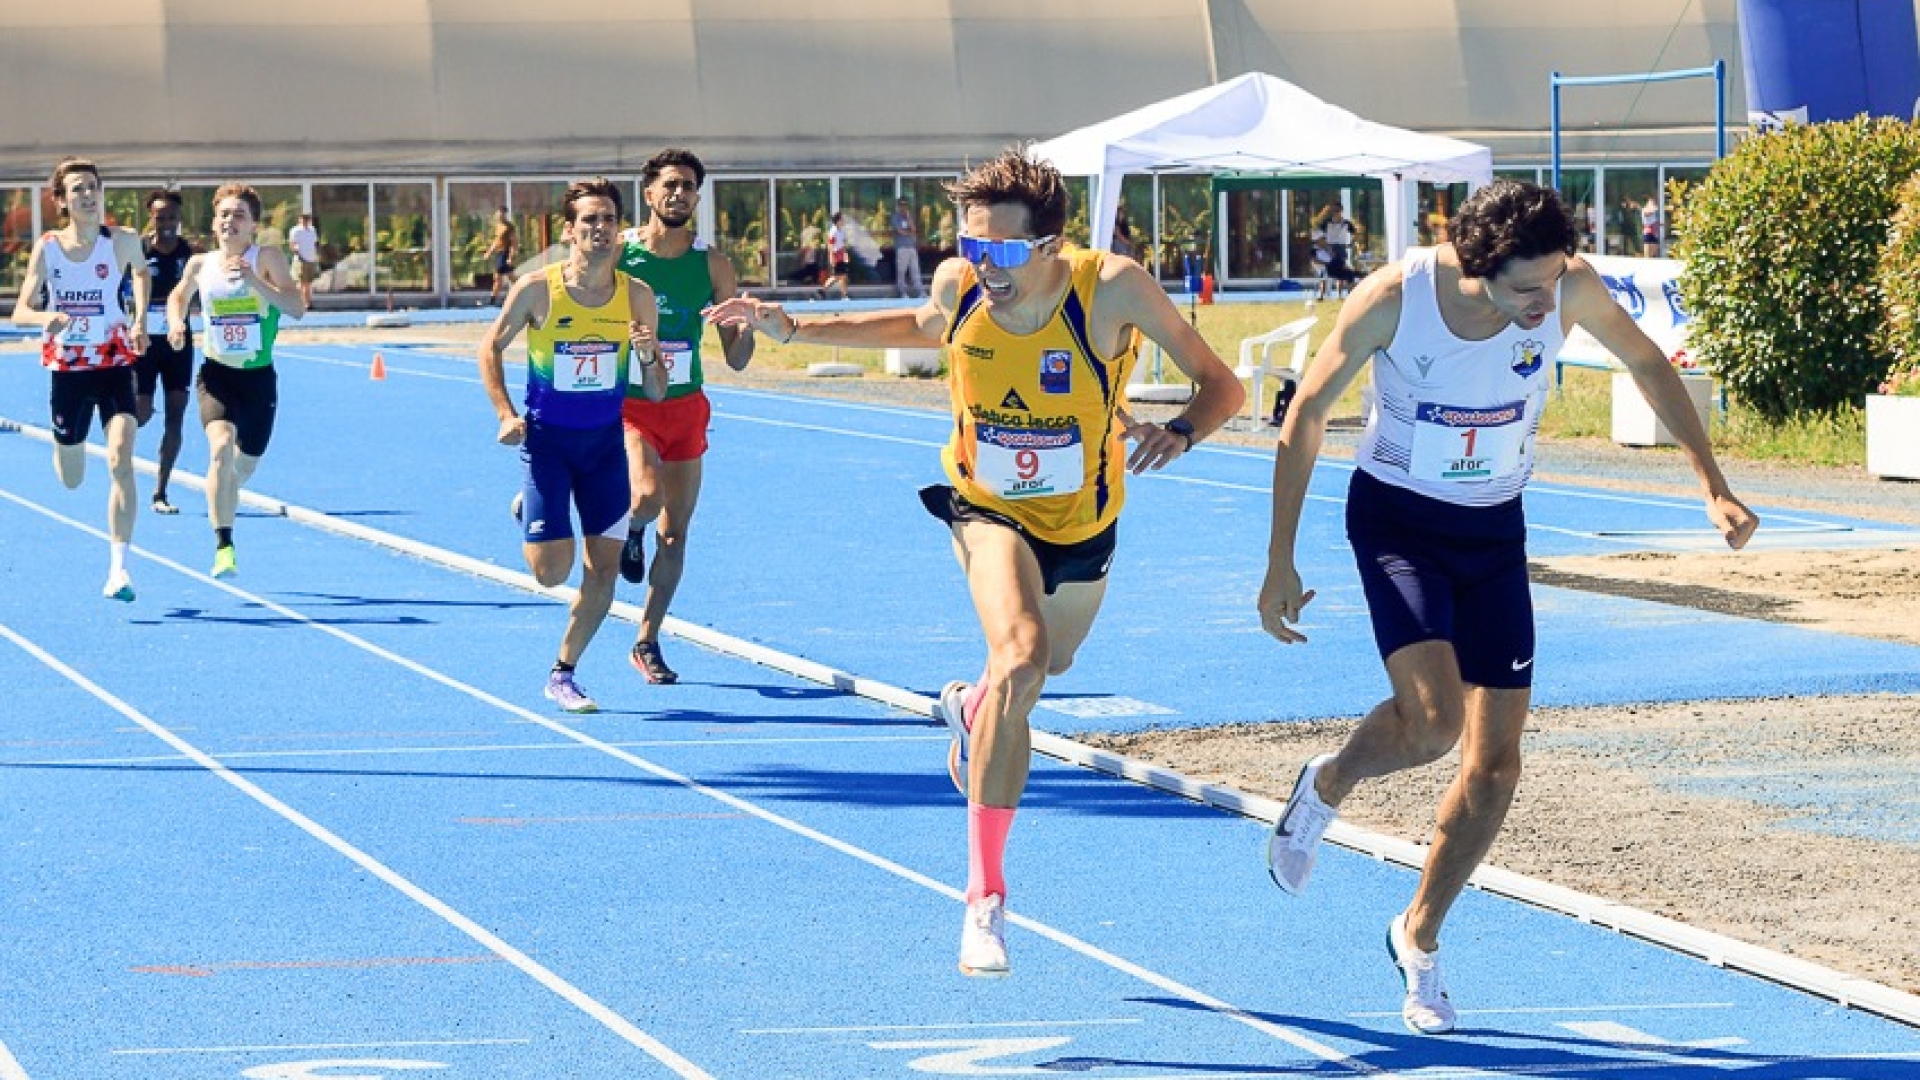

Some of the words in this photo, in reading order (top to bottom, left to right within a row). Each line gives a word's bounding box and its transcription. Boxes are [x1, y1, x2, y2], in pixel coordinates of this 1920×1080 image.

[223, 324, 248, 342] 89
[571, 355, 599, 376] 71
[1461, 428, 1477, 457] 1
[1014, 449, 1040, 480] 9
